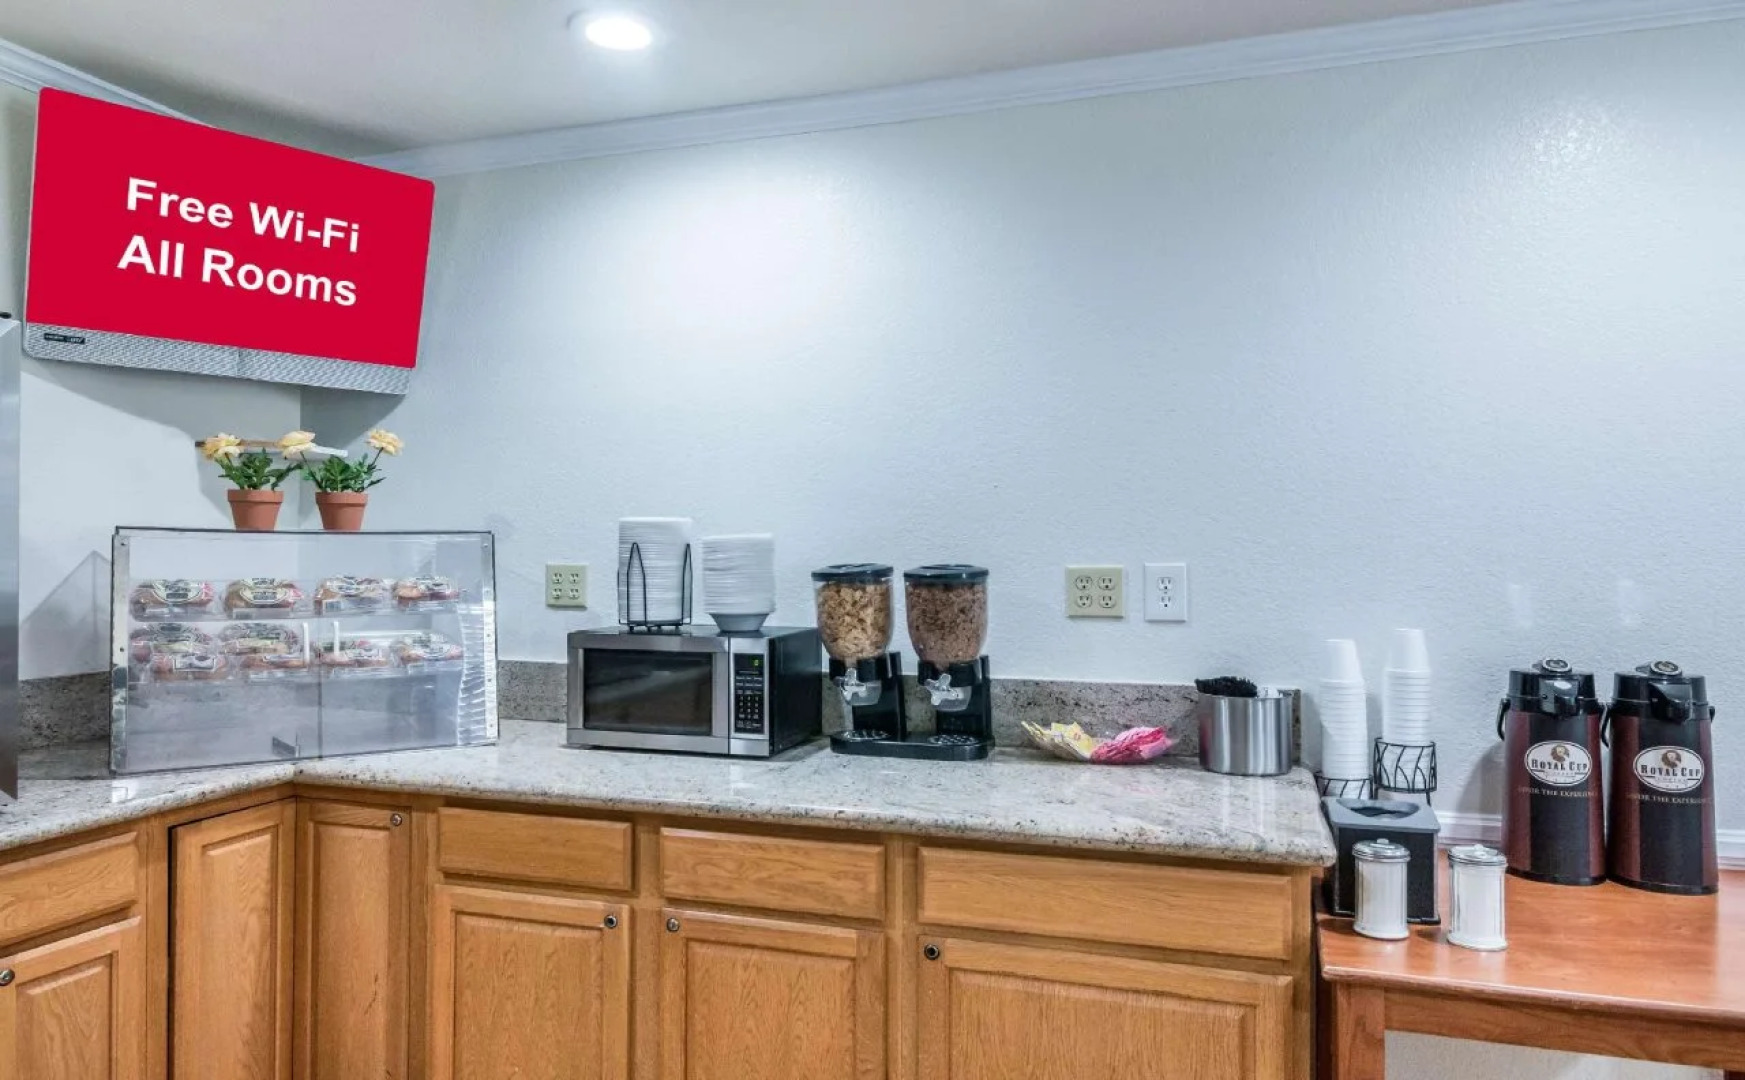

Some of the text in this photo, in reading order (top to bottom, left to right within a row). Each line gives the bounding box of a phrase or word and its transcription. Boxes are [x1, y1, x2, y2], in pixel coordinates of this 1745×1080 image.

[127, 177, 359, 252] Free Wi-Fi
[117, 234, 357, 306] All Rooms
[1531, 759, 1566, 771] ROYAL
[1640, 764, 1678, 777] ROYAL
